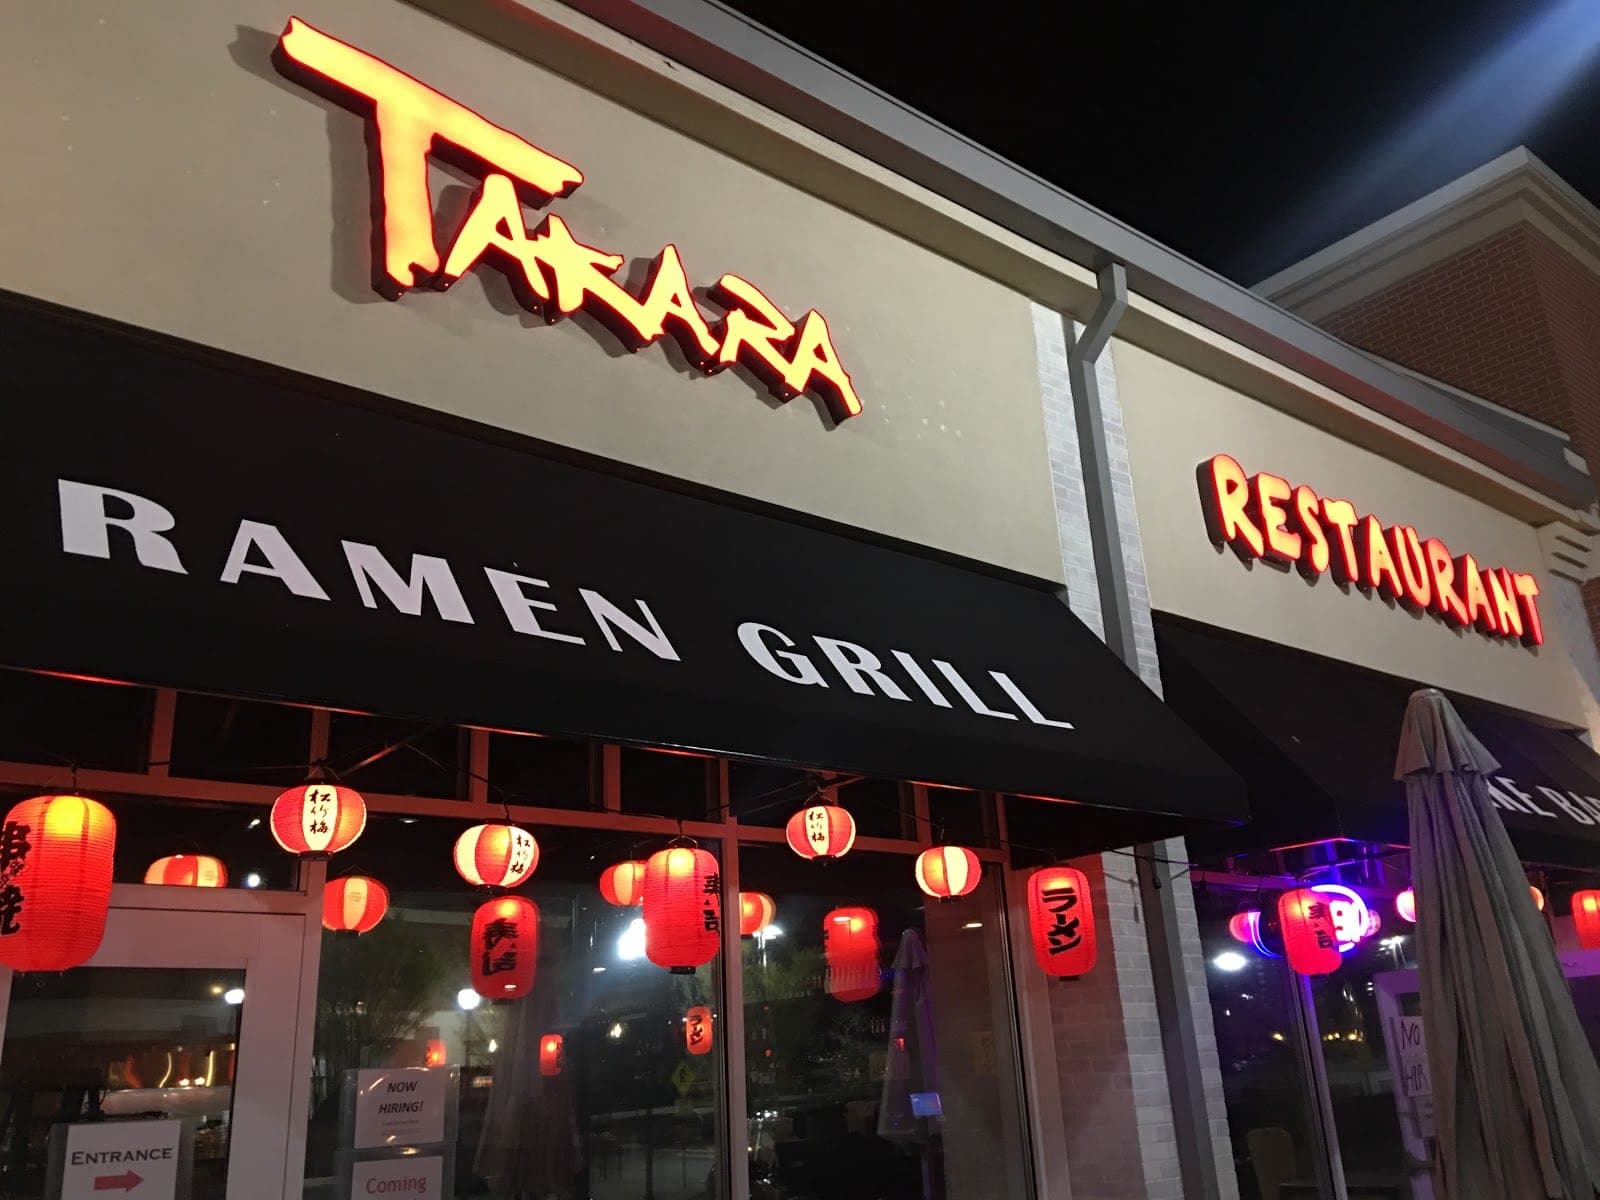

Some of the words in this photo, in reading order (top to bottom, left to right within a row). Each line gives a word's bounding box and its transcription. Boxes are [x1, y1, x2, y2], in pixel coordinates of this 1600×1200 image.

[277, 15, 863, 417] TAKARA
[1206, 453, 1544, 646] RESTAURANT
[57, 478, 682, 662] RAMEN
[736, 621, 1076, 730] GRILL
[1535, 785, 1600, 825] BA
[1041, 886, 1083, 957] ラーメン
[378, 1100, 425, 1114] HIRING!
[386, 1080, 418, 1094] NOW
[70, 1147, 174, 1166] ENTRANCE
[365, 1175, 428, 1195] Coming
